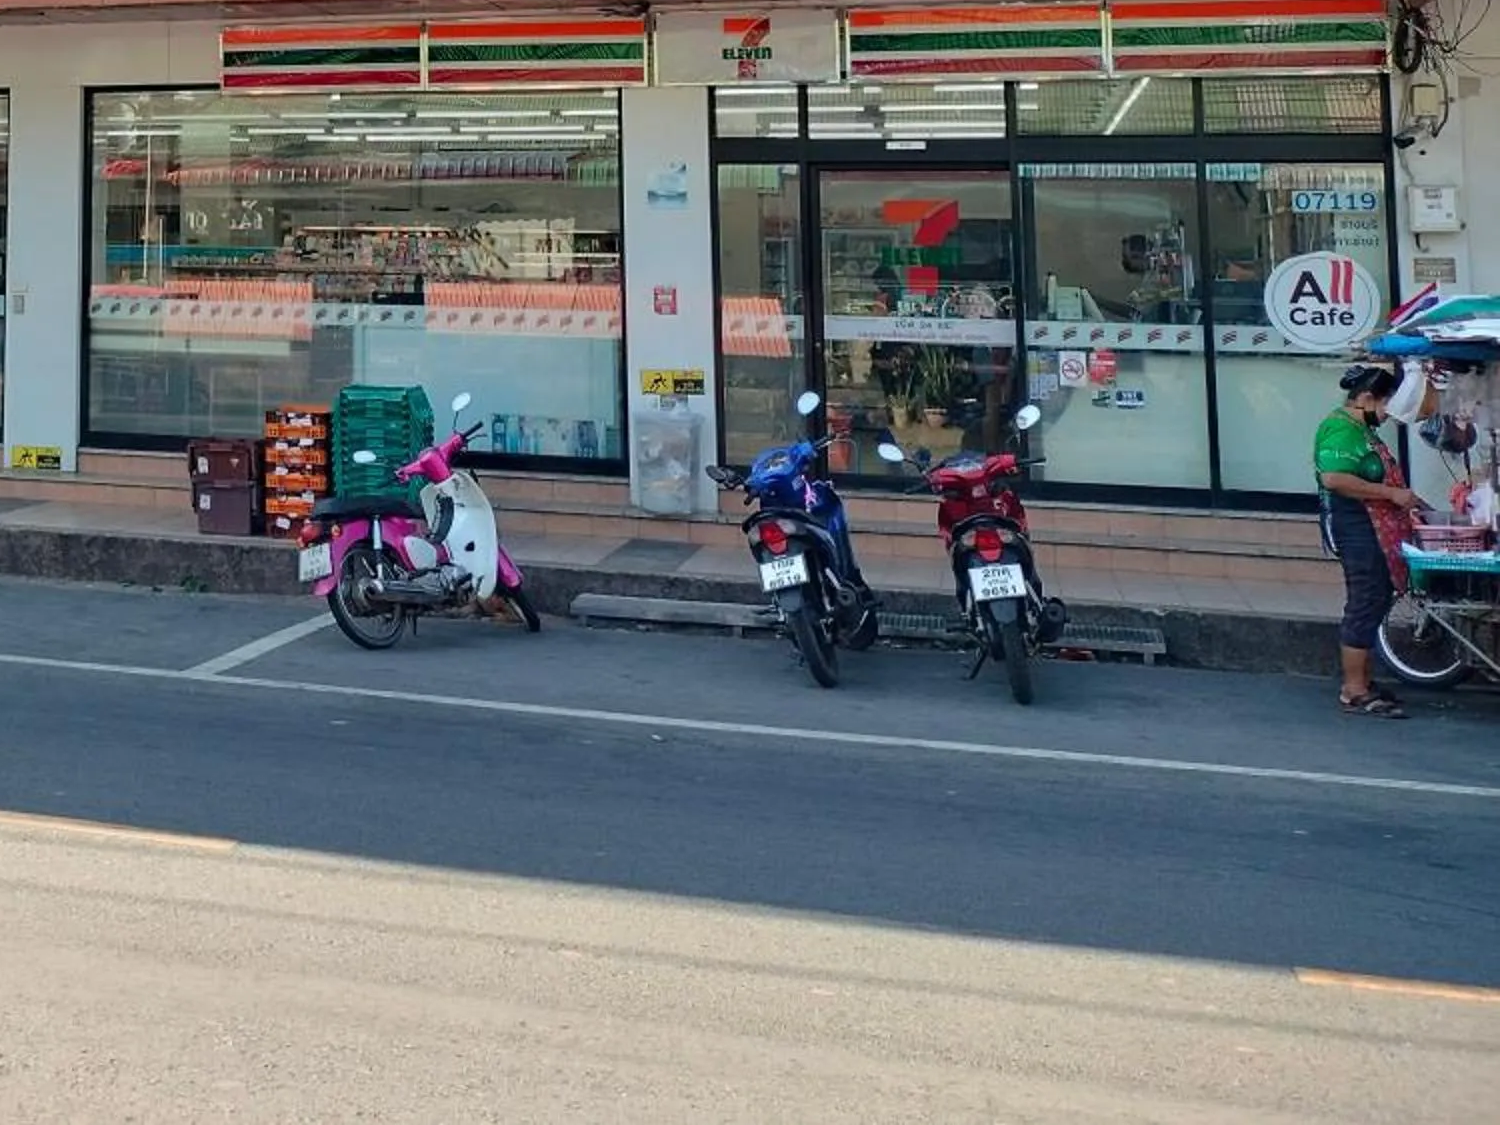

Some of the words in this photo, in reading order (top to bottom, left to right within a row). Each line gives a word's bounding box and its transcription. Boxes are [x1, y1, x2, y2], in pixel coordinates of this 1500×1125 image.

[1295, 192, 1377, 210] 07119
[1289, 259, 1354, 304] All
[1289, 307, 1355, 326] Cafe
